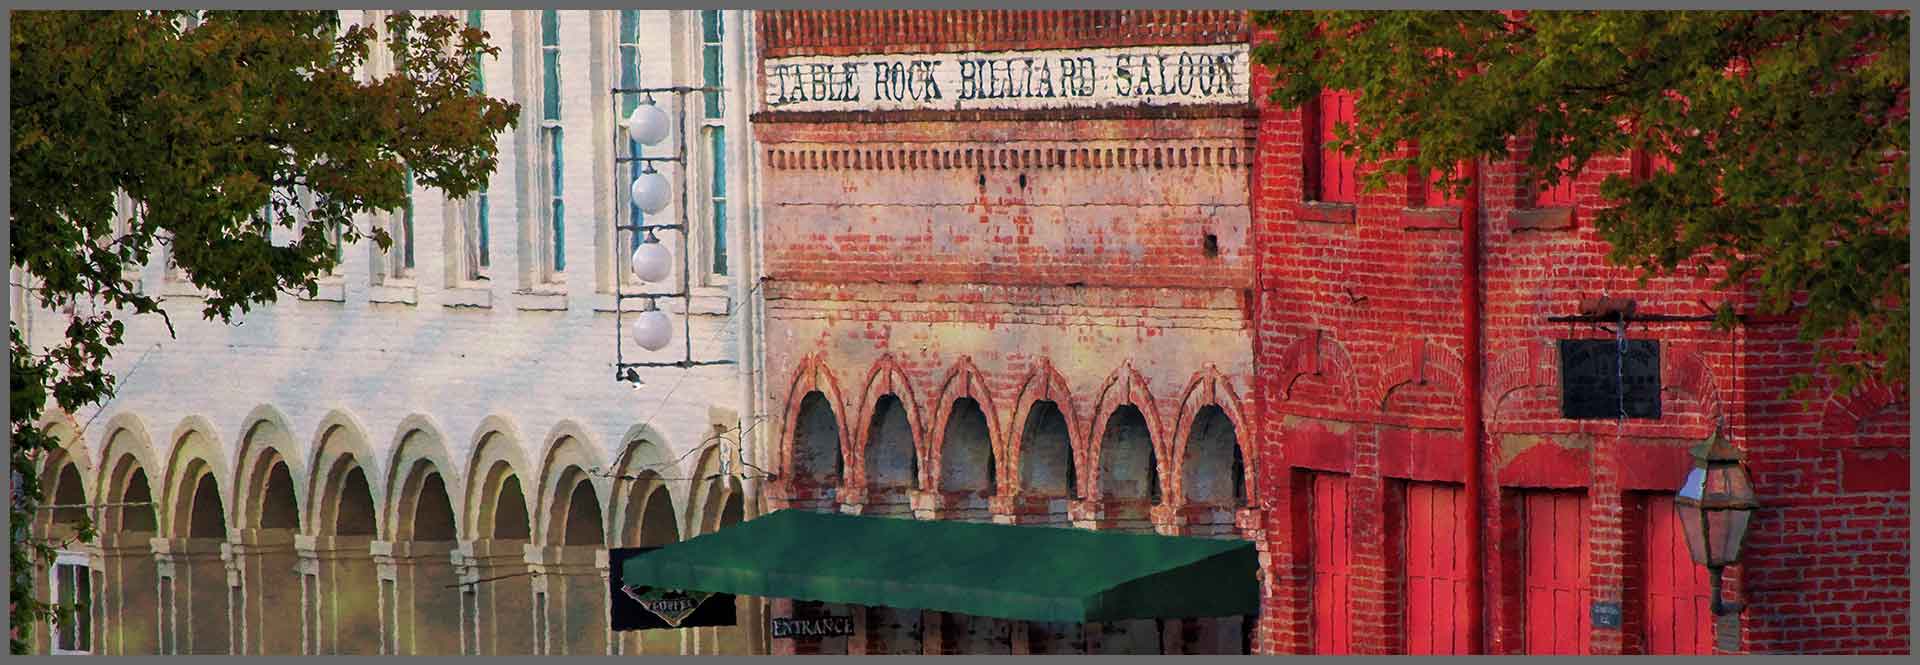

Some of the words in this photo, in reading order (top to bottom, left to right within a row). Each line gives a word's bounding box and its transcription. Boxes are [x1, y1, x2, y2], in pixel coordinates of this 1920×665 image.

[775, 62, 867, 103] TABLE
[873, 60, 943, 102] ROCK
[959, 56, 1096, 99] BILLIARD
[1115, 51, 1237, 97] SALOON
[773, 618, 854, 636] ENTRANCE
